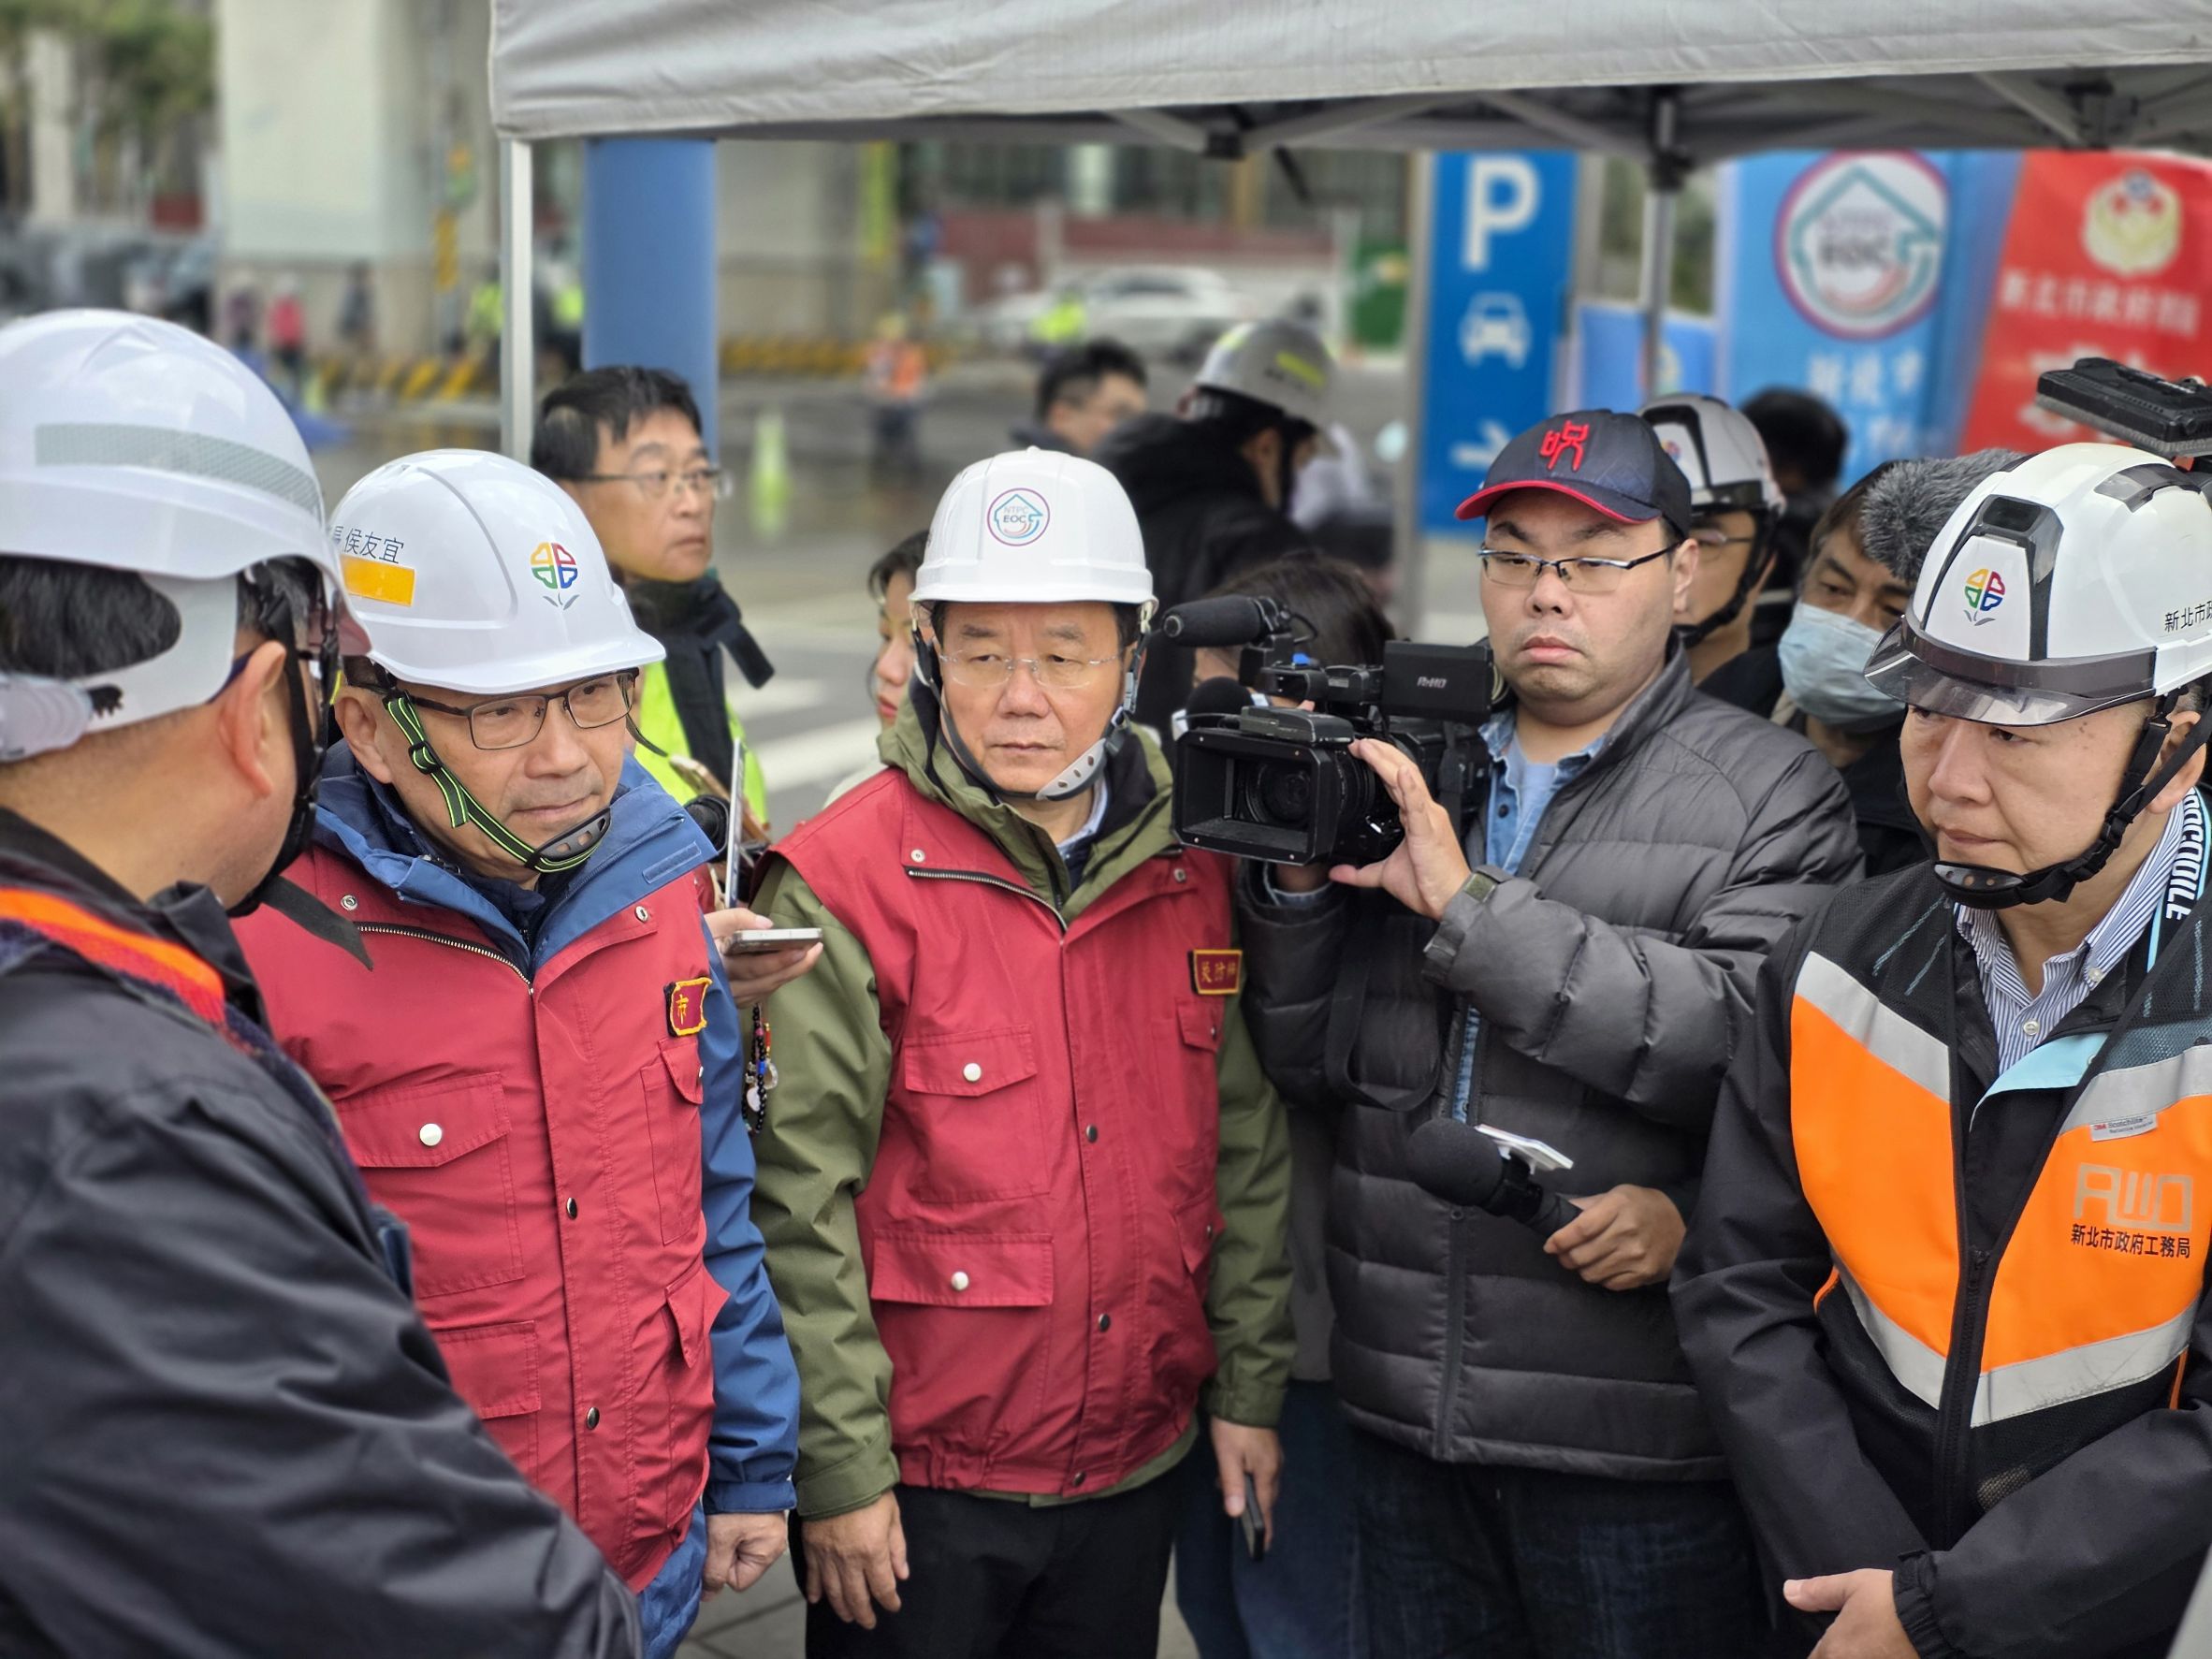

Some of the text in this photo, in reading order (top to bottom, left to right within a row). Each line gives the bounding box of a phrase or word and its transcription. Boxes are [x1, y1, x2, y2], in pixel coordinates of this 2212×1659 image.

[1463, 158, 1541, 268] P
[1003, 515, 1027, 523] EOC
[2071, 1223, 2191, 1259] 新北市政府工務局
